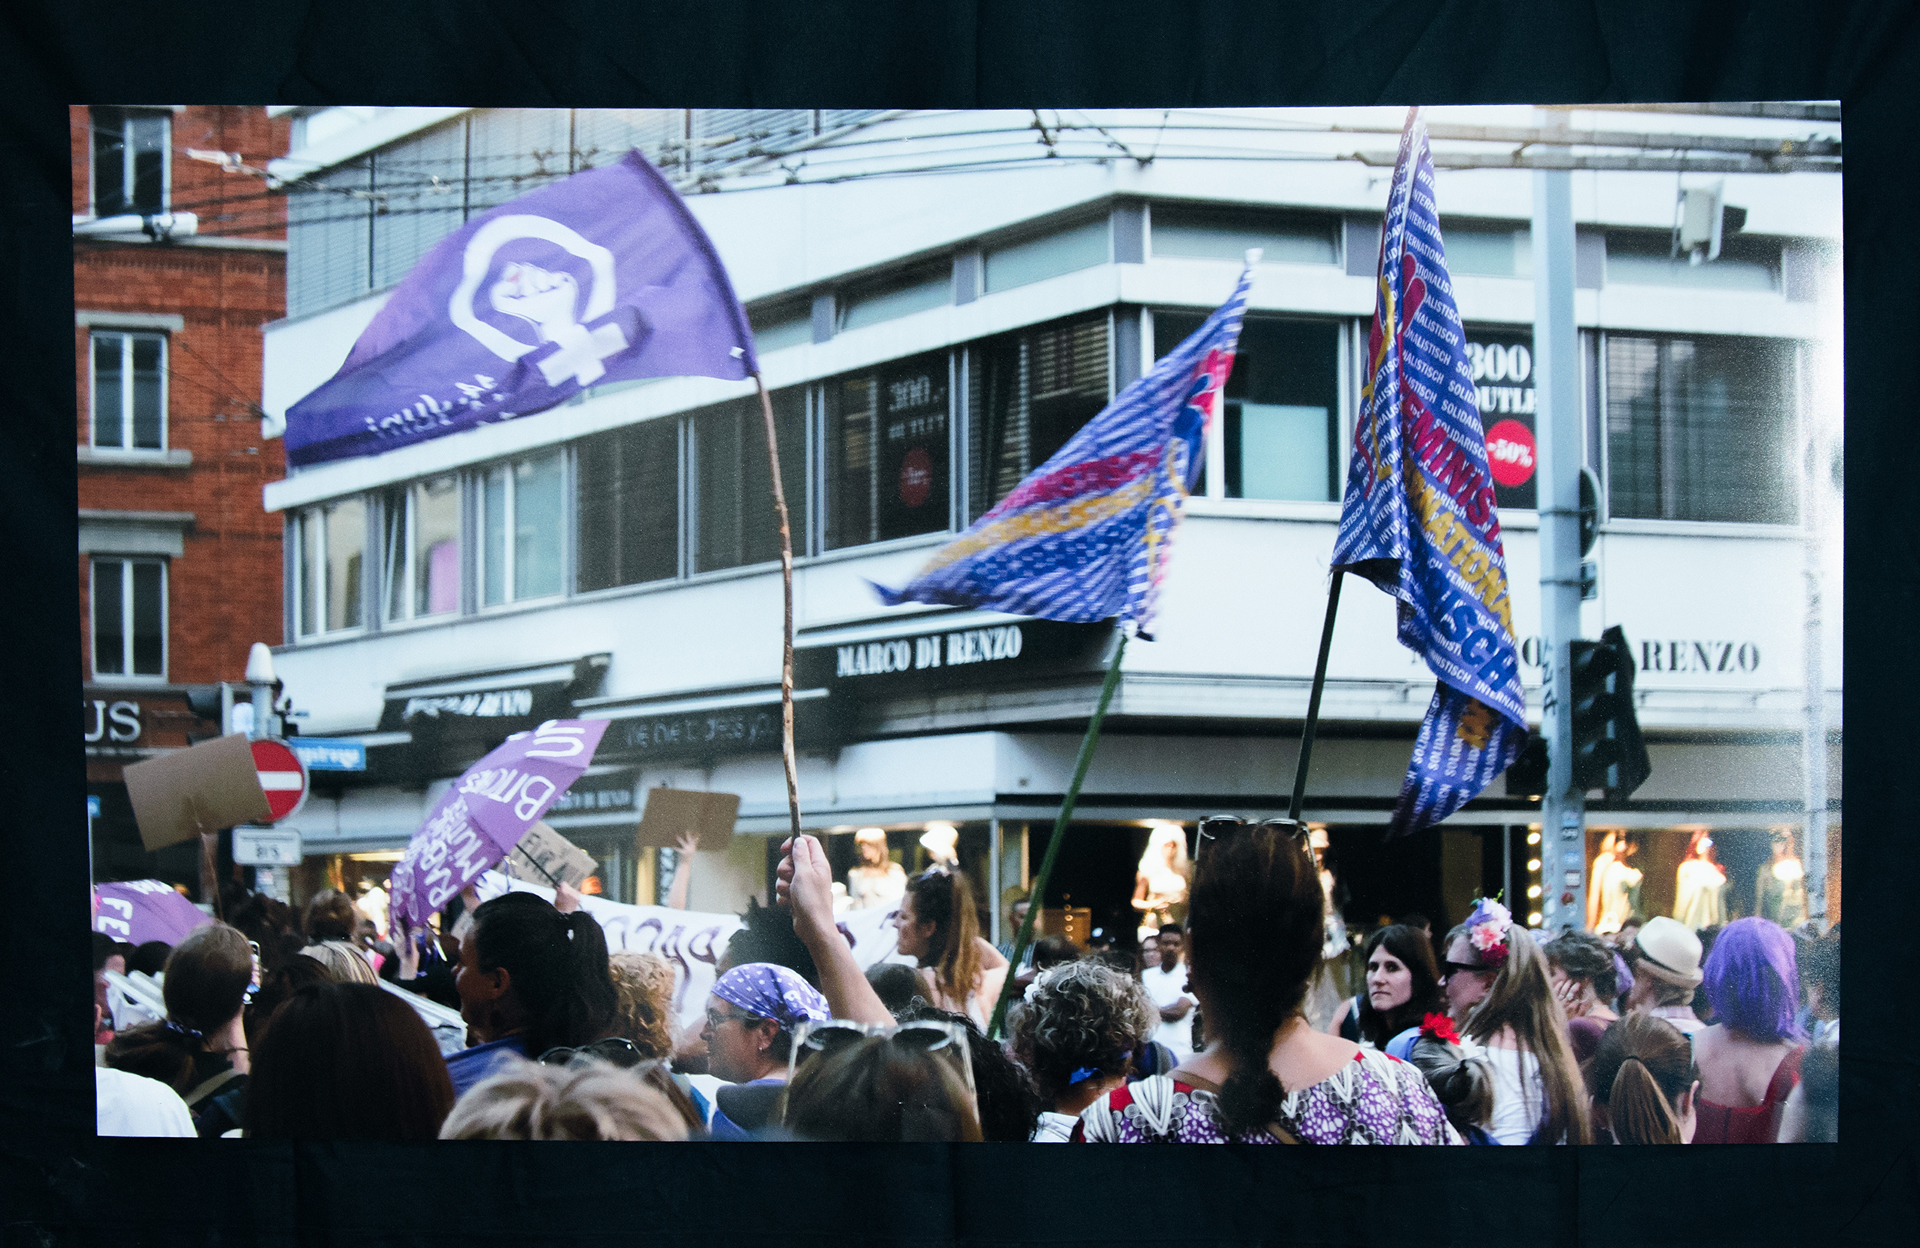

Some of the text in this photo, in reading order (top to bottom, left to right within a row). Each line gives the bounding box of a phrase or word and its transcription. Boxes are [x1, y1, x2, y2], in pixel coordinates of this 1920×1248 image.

[836, 625, 1023, 678] MARCO DI RENZO
[1640, 640, 1760, 672] RENZO
